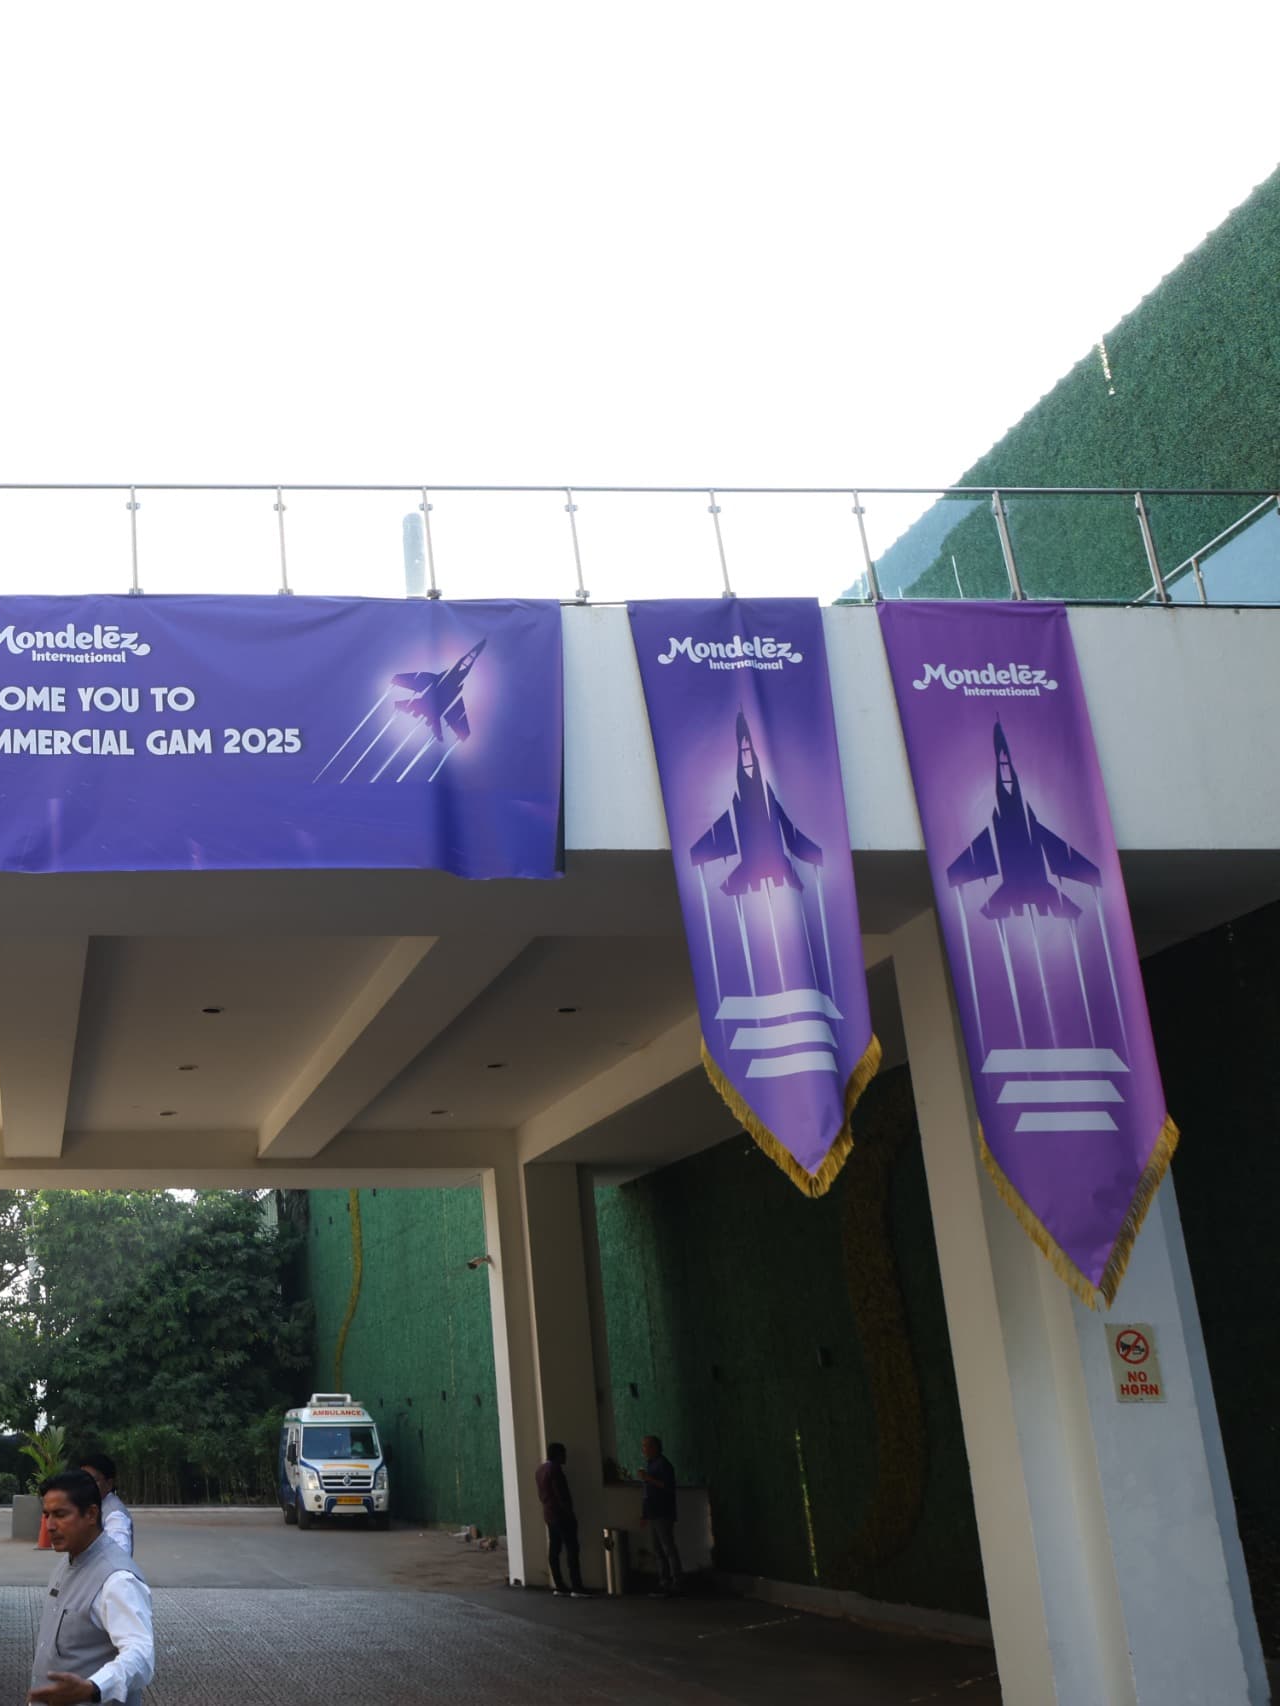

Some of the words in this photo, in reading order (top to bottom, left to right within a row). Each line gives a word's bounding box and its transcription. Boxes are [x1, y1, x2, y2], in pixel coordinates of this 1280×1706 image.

[31, 650, 126, 663] International
[657, 635, 803, 665] Mondelēz
[708, 658, 783, 671] International
[913, 663, 1058, 690] Mondelēz
[964, 685, 1040, 697] International
[77, 686, 139, 712] YOU
[150, 686, 195, 712] TO
[146, 729, 212, 755] GAM
[223, 728, 301, 754] 2025
[1127, 1371, 1148, 1382] NO
[1120, 1384, 1159, 1395] HORN
